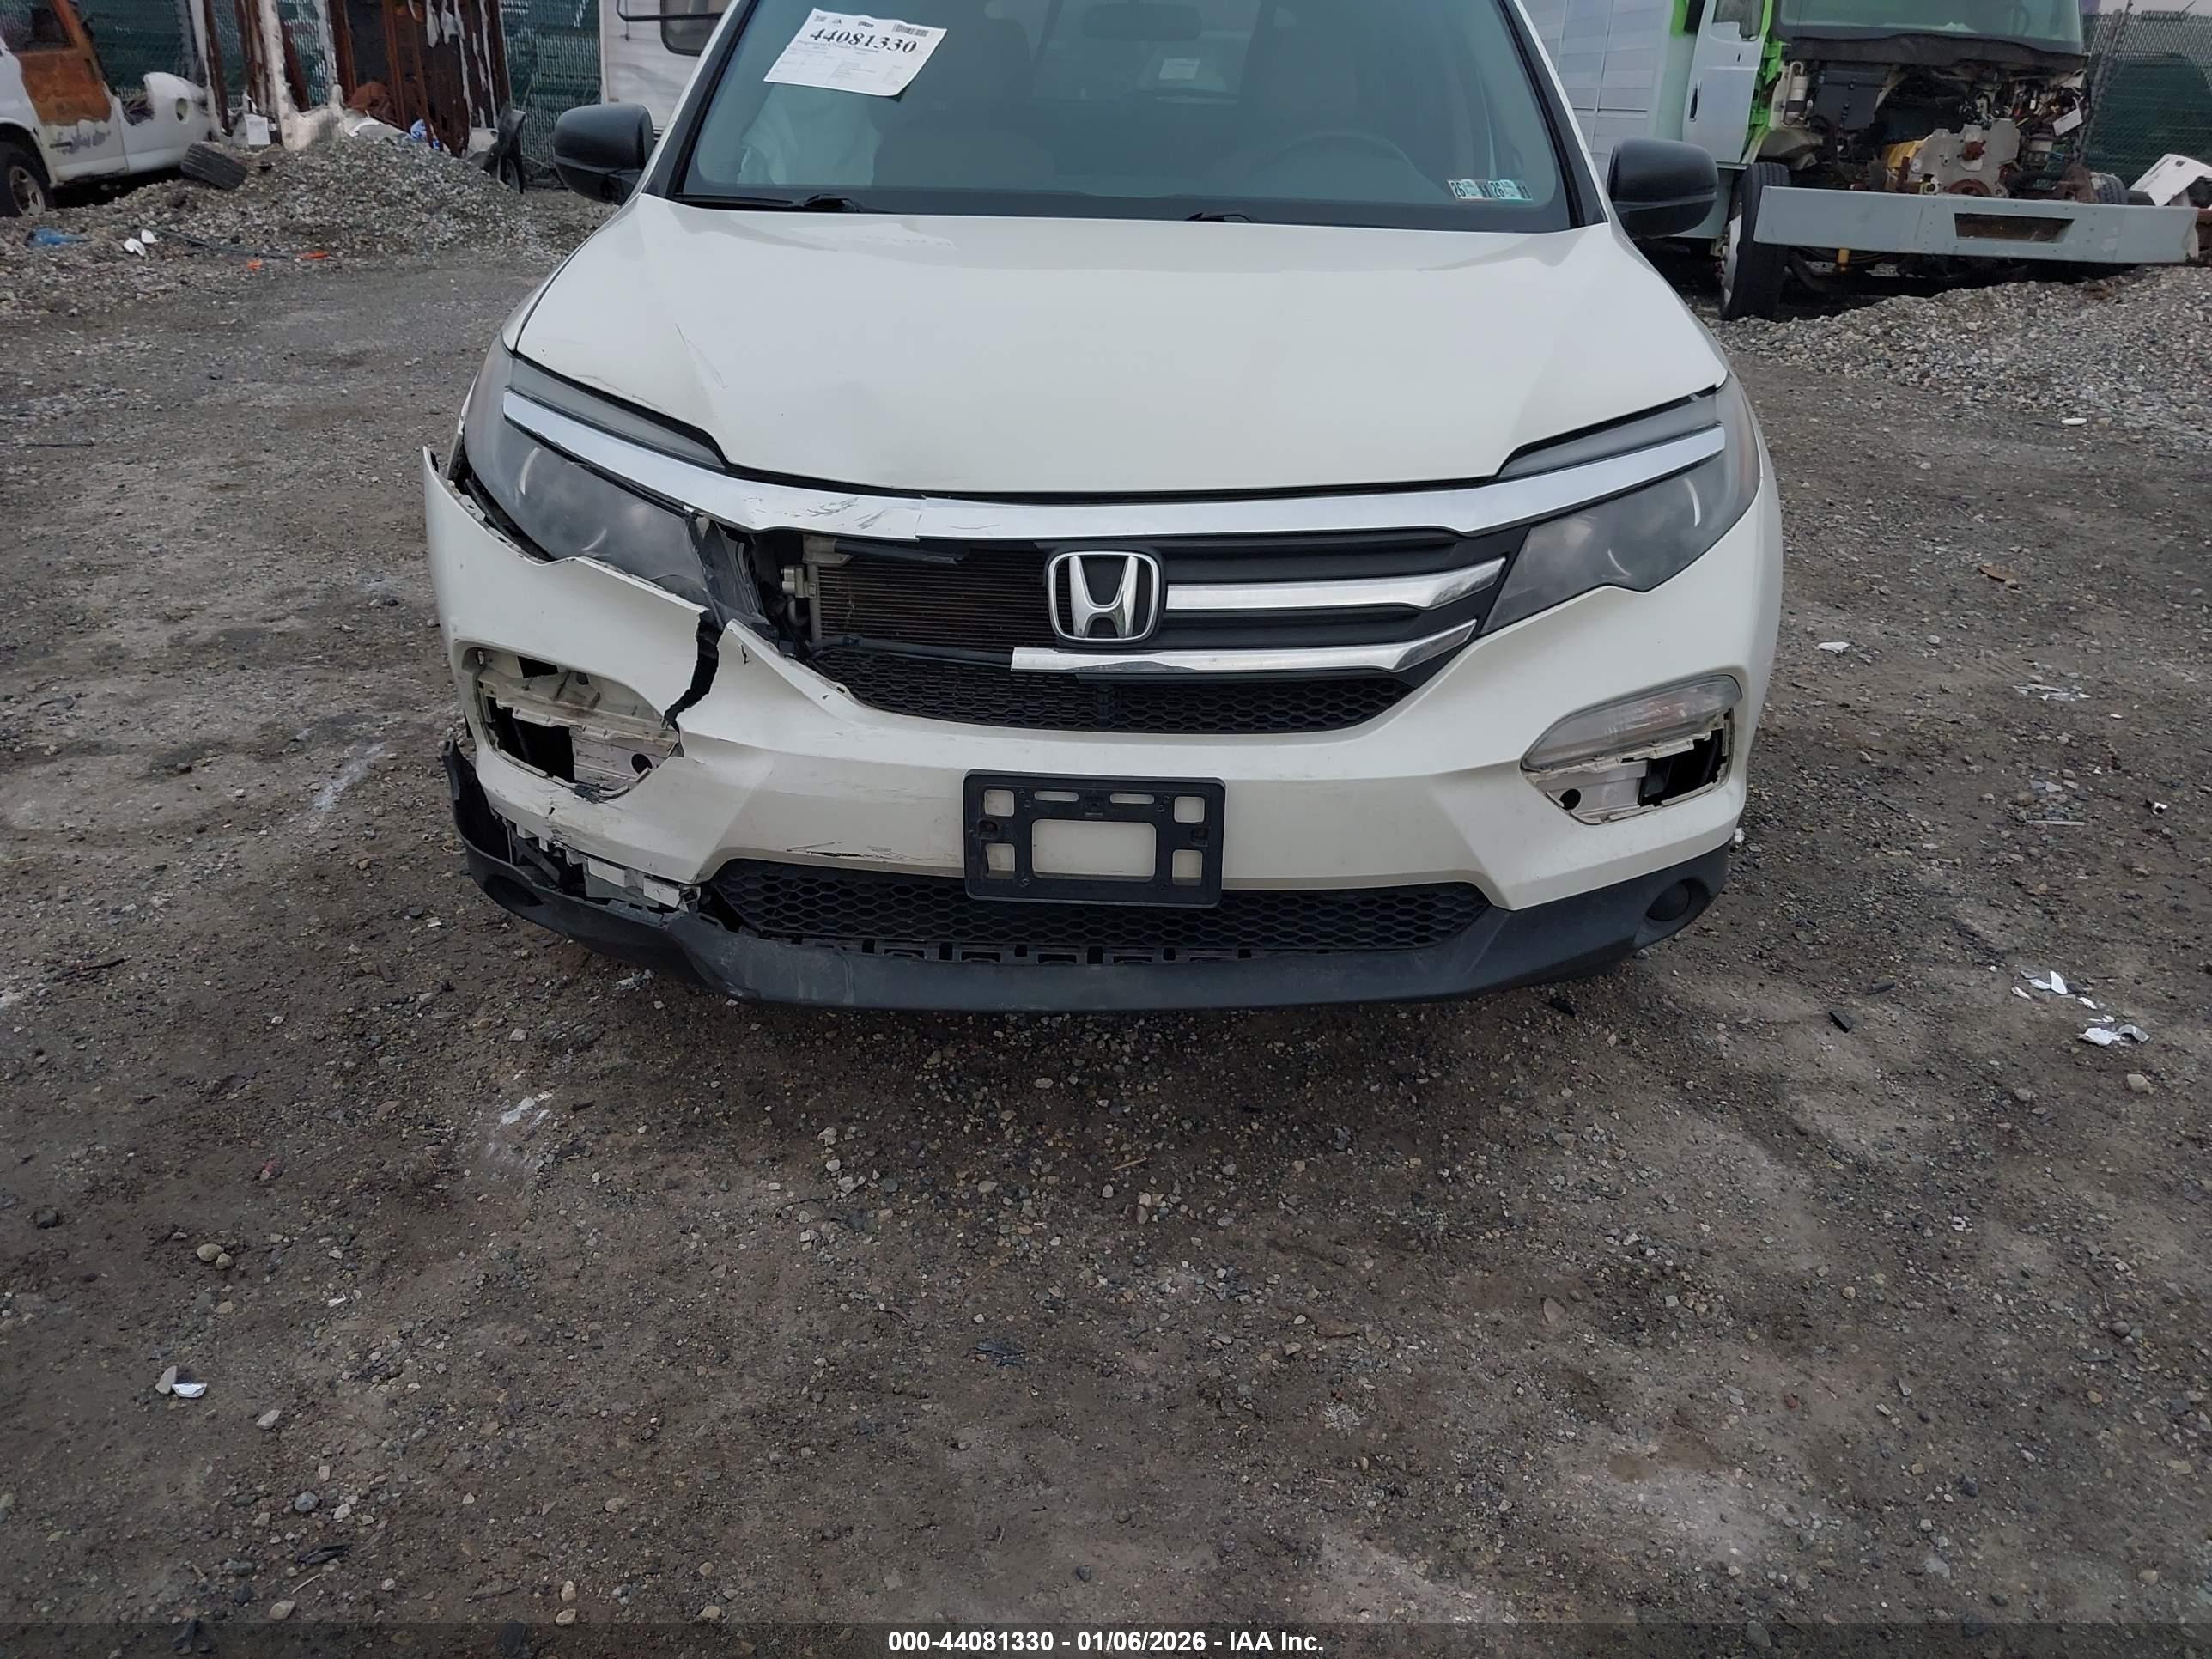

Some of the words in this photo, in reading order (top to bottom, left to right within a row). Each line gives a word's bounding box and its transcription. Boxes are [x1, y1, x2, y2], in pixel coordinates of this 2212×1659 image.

[810, 28, 917, 53] 44081330
[1450, 182, 1466, 197] 26
[1490, 182, 1505, 198] 26
